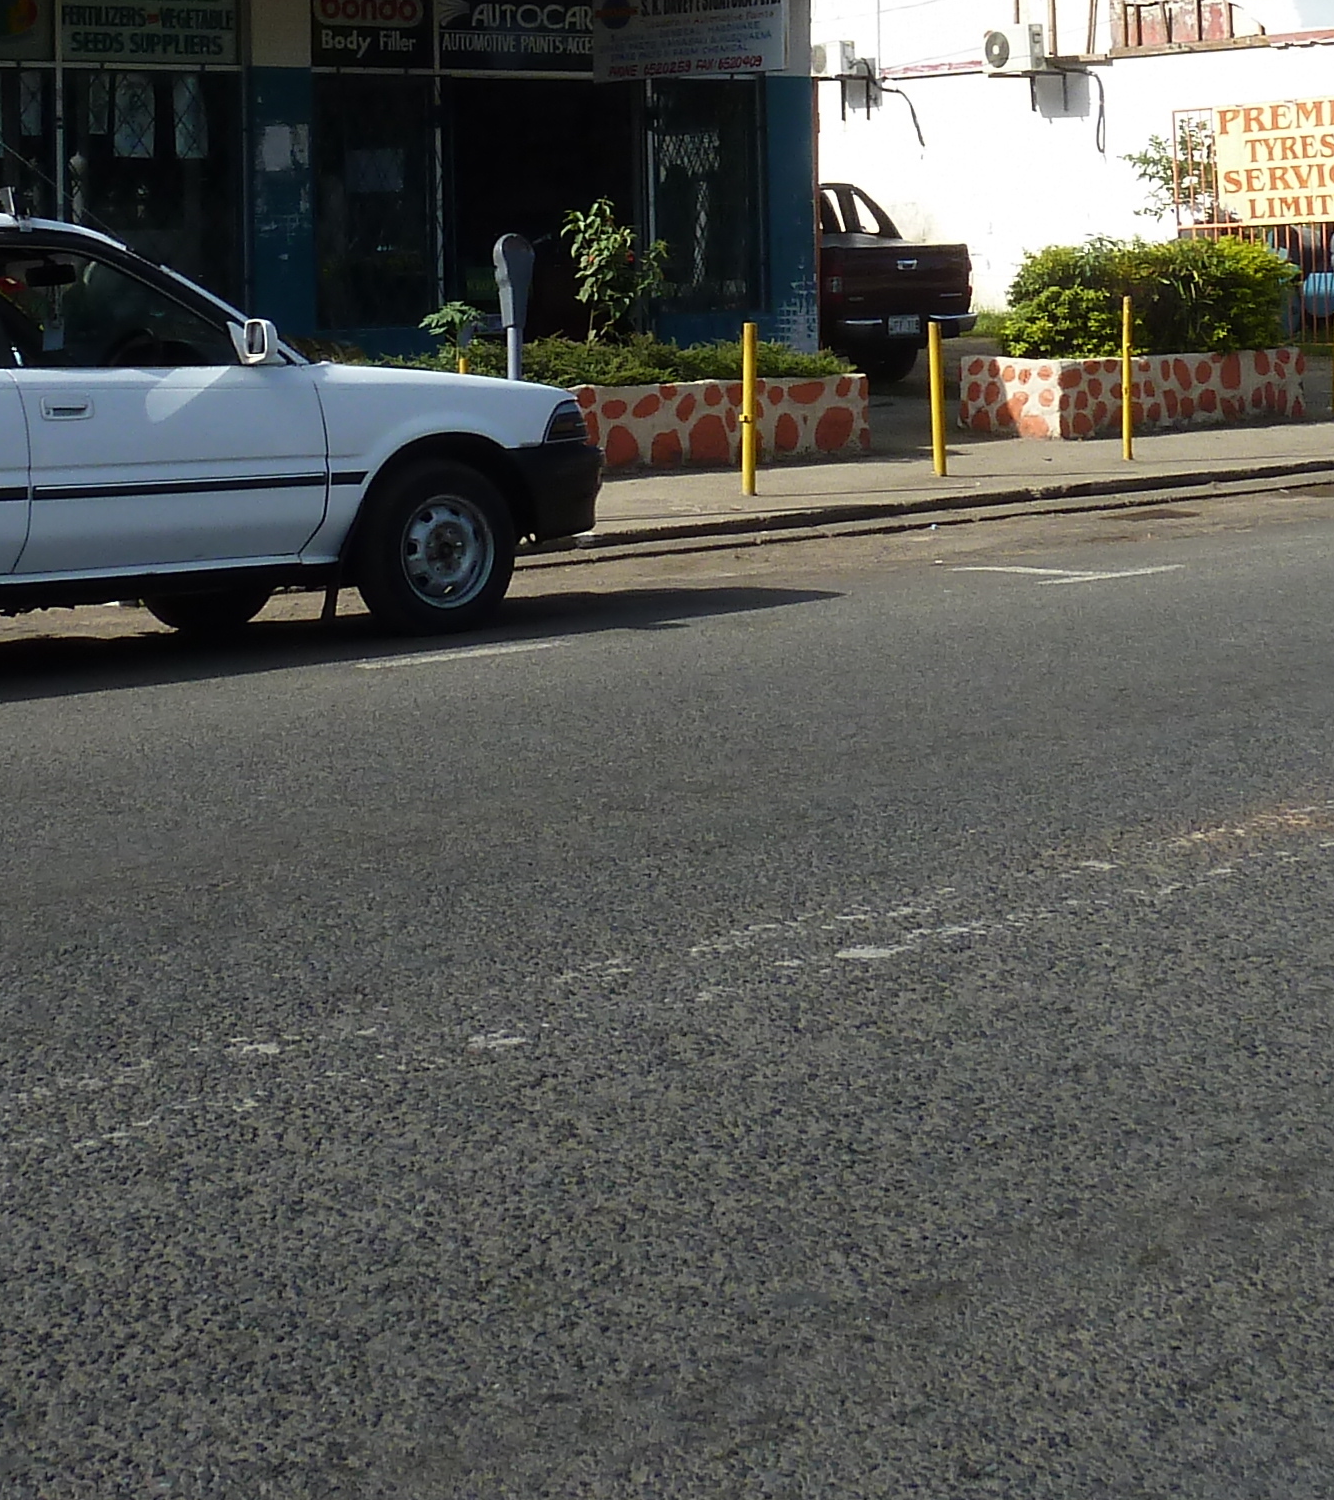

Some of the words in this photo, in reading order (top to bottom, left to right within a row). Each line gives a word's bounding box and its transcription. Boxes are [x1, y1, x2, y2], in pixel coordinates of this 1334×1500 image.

[72, 32, 124, 53] SEEDS
[129, 33, 223, 55] SUPPLIERS
[321, 29, 371, 58] Body
[379, 30, 417, 51] Filler
[443, 33, 516, 52] AUTOMOTIVE
